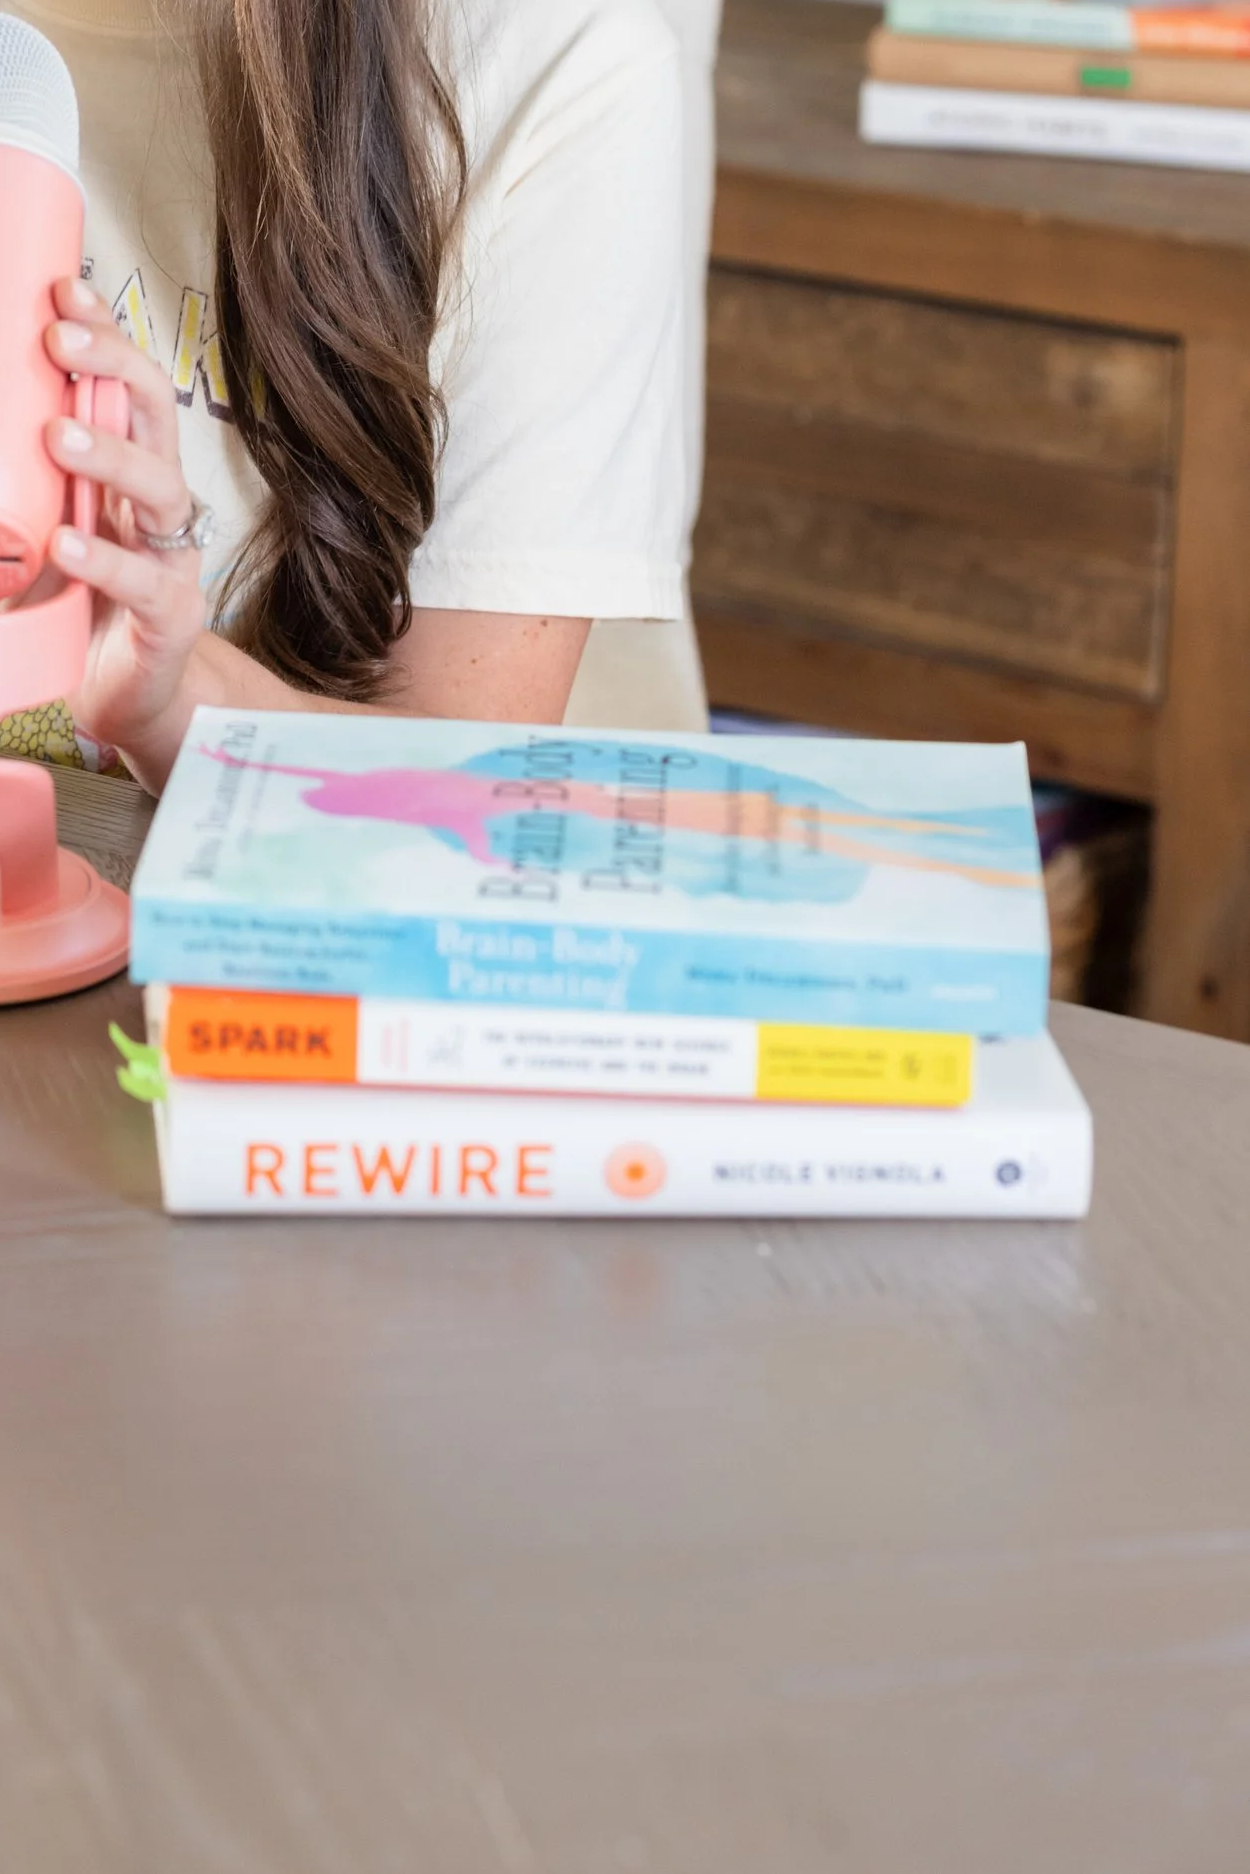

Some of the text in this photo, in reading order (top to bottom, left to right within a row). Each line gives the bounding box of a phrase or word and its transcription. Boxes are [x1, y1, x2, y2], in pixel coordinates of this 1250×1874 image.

[477, 734, 602, 903] Brain-Body
[579, 748, 697, 895] Parenting
[448, 960, 630, 1011] Parenting
[187, 1019, 333, 1059] SPARK
[244, 1142, 554, 1197] REWIRE
[712, 1161, 946, 1185] NICOLE VIGNOLA
